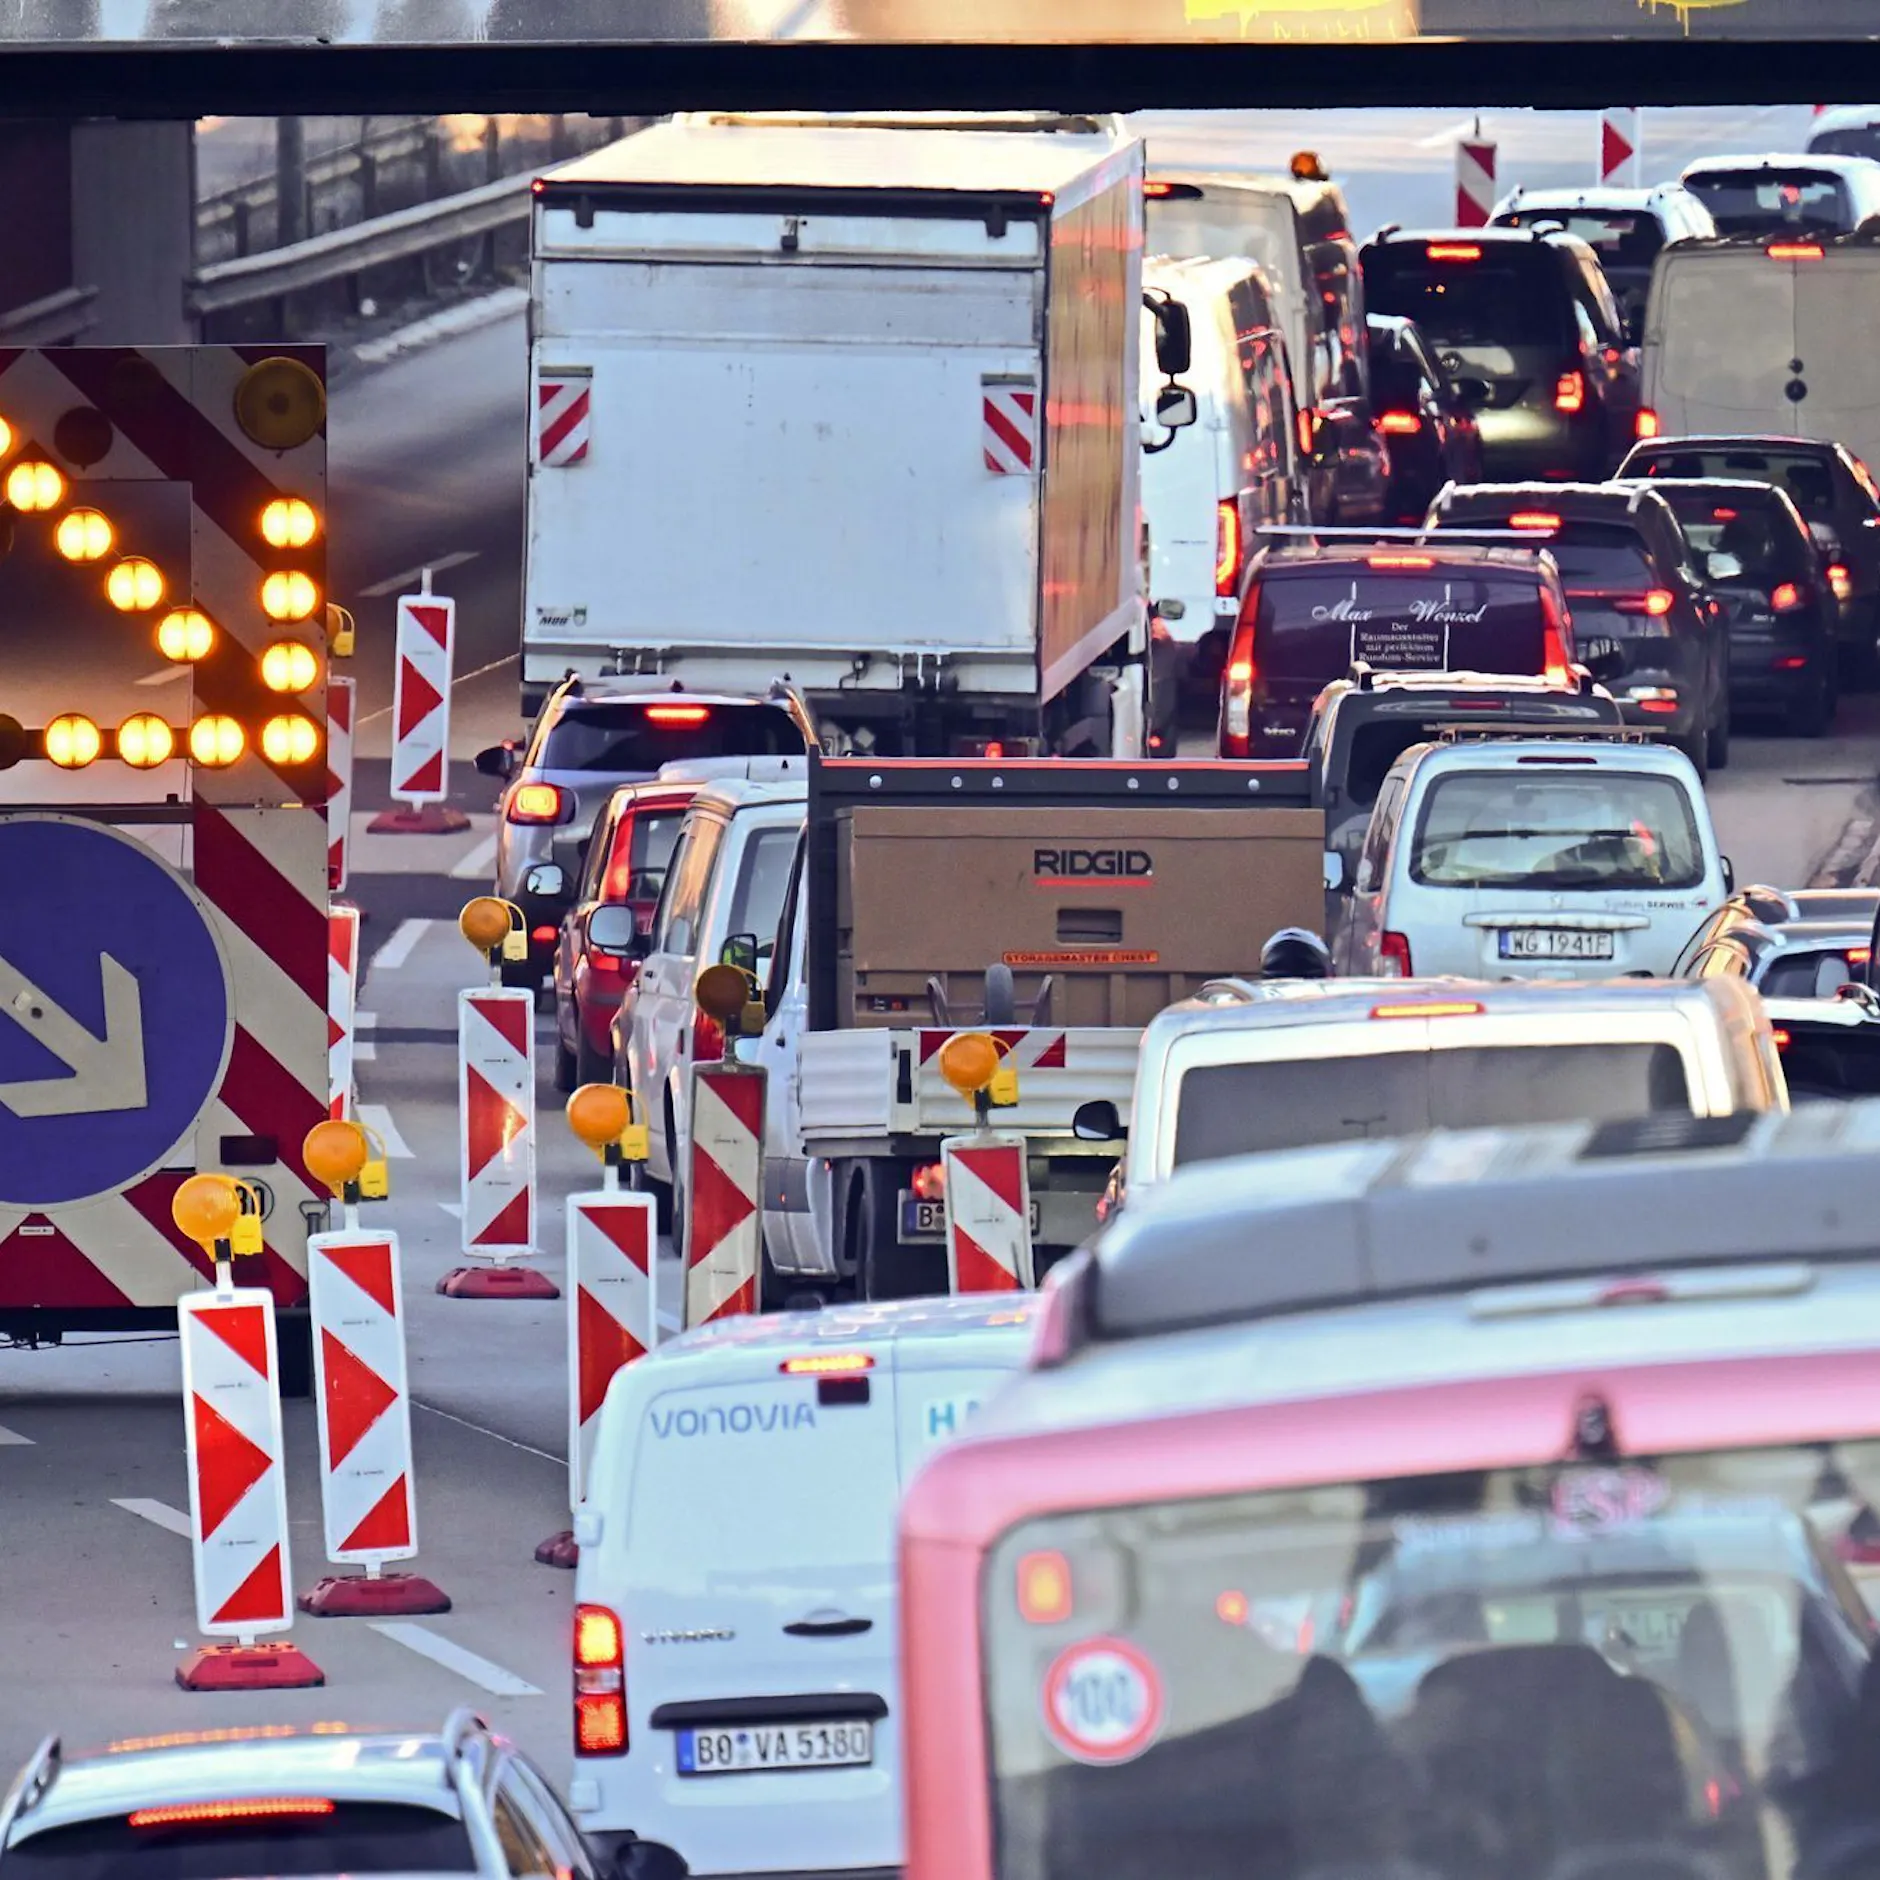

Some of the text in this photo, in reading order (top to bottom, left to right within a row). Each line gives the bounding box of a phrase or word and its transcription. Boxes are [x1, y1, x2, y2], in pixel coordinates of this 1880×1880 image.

[1312, 599, 1487, 623] Max Wenzel
[1391, 622, 1409, 632] Der
[1034, 849, 1153, 875] RIDGID
[1512, 935, 1538, 954] WG
[919, 1205, 934, 1228] B
[651, 1401, 816, 1439] VONOVIA
[755, 1730, 789, 1761] VA
